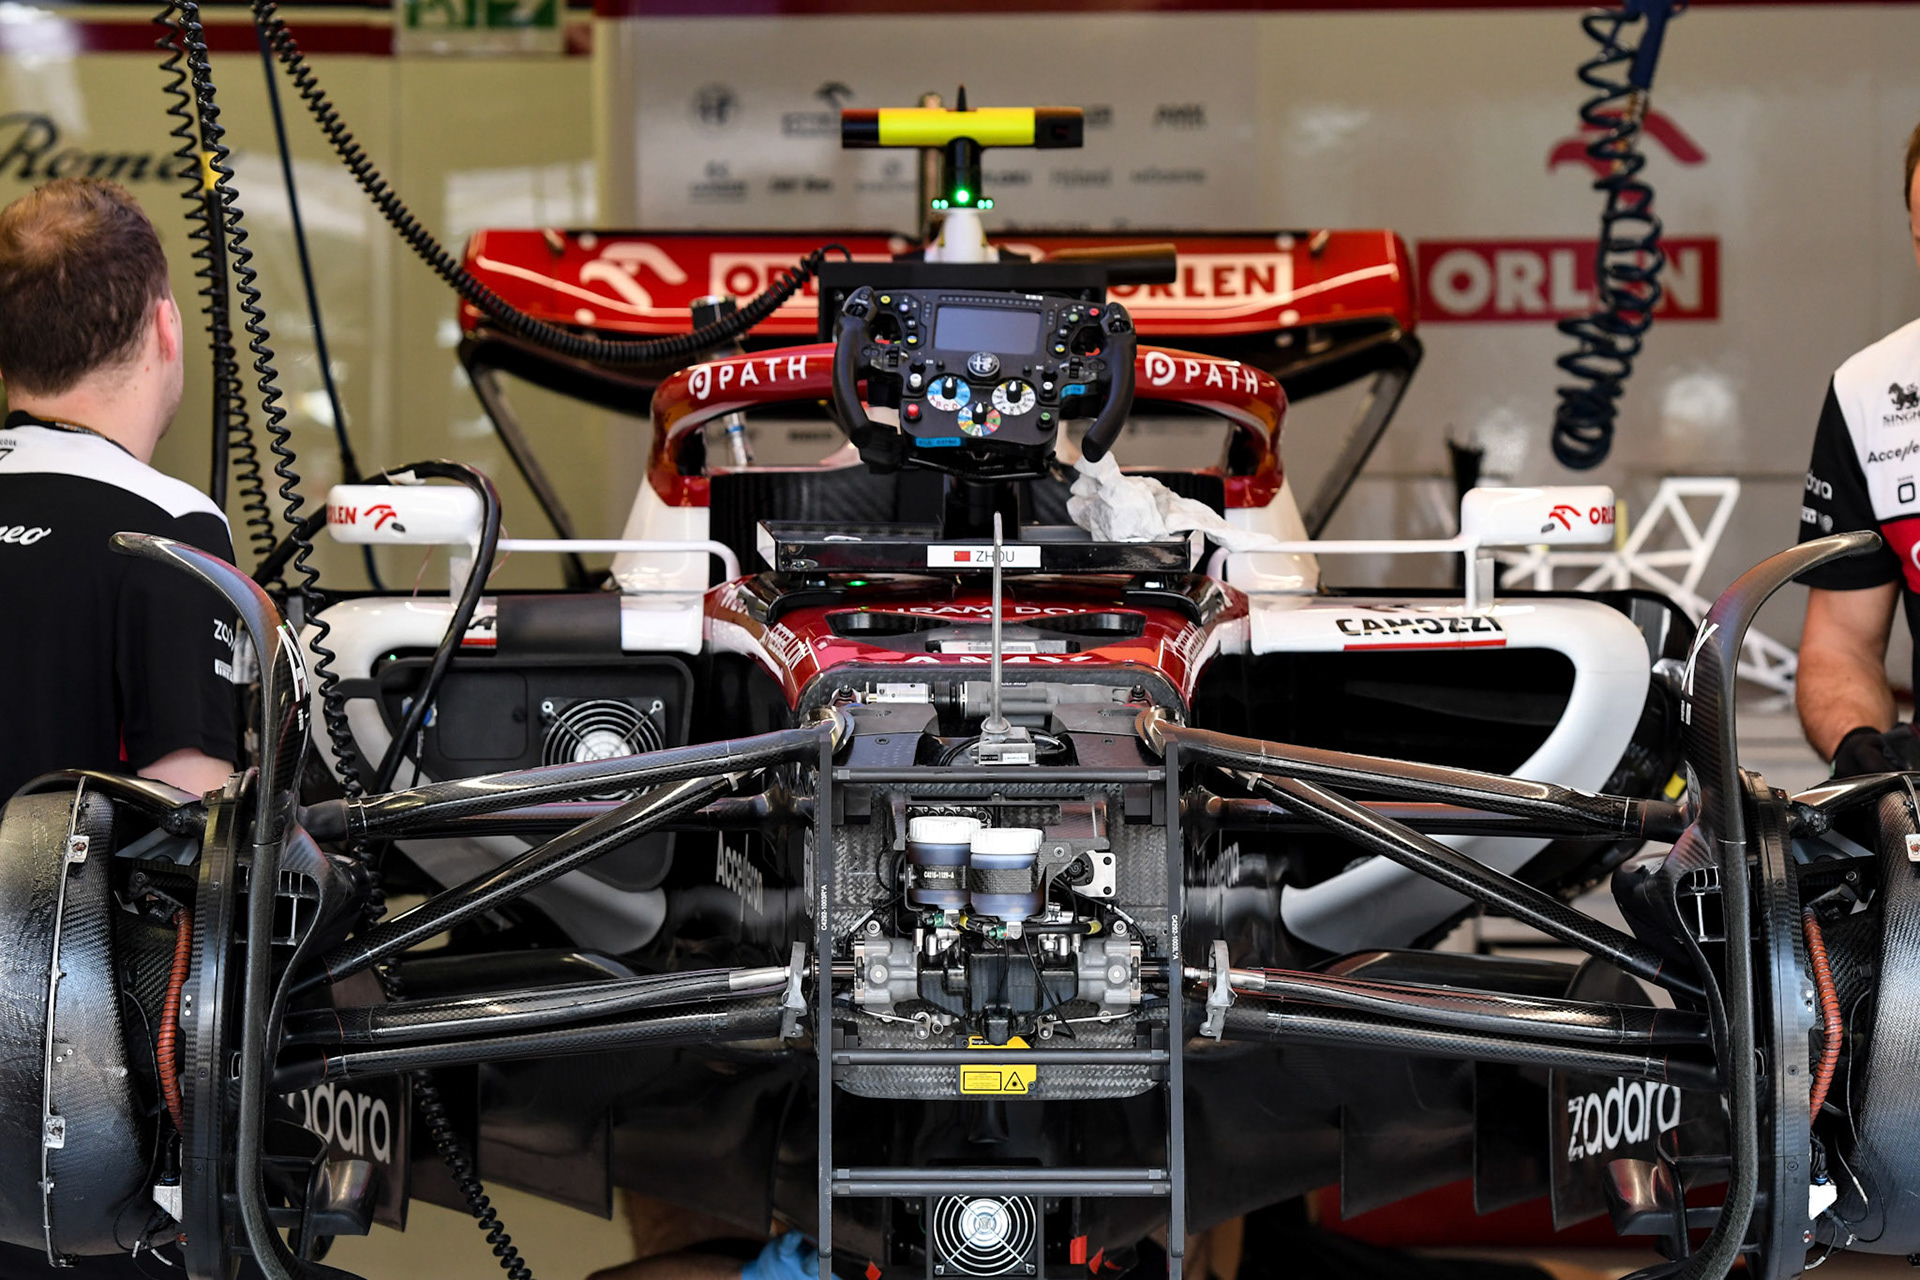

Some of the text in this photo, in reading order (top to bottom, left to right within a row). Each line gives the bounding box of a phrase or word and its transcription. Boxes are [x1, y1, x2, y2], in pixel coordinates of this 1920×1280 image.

[718, 354, 808, 392] PATH
[1184, 359, 1260, 395] PATH
[0, 524, 52, 546] eo
